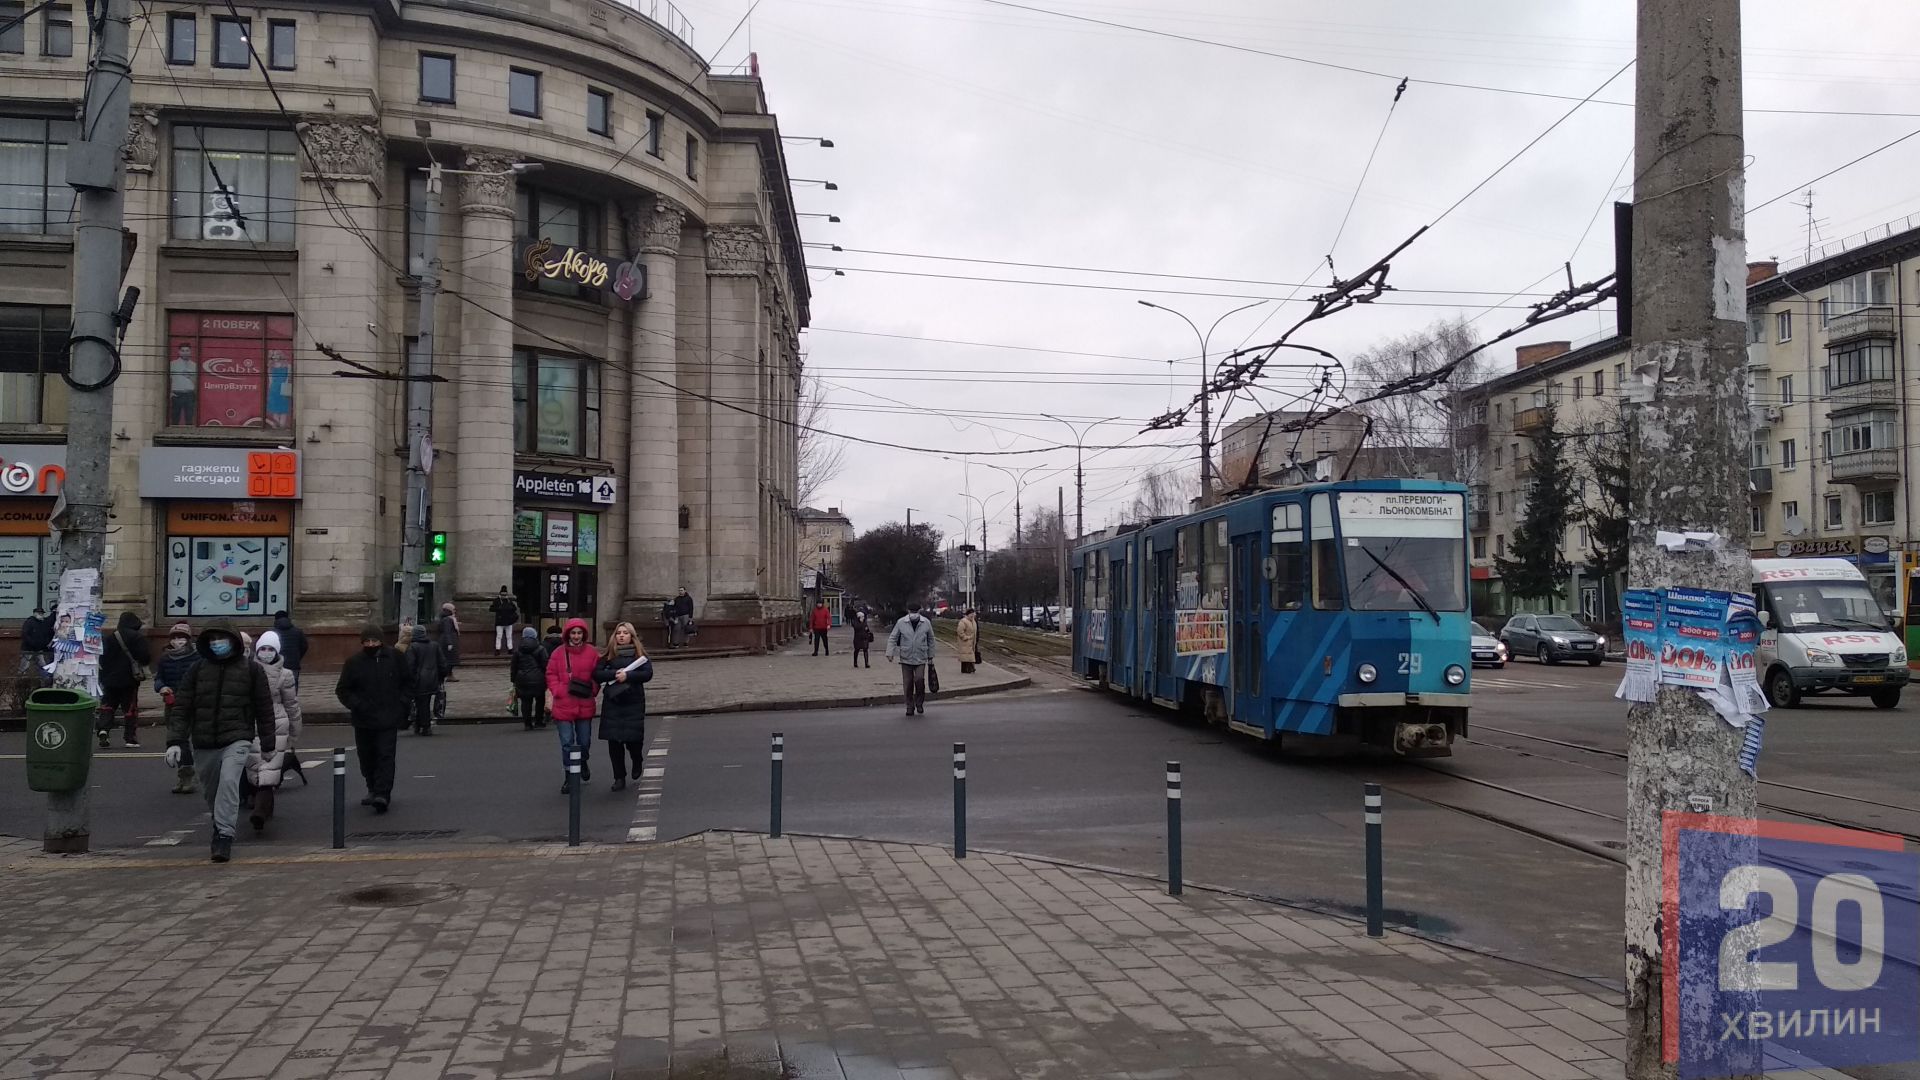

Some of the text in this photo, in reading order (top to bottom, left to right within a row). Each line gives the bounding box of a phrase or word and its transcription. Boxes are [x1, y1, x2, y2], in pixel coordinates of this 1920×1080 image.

[544, 247, 609, 286] Акорд
[203, 319, 260, 330] 2 ПОВЕРХ
[181, 465, 240, 475] гаджети
[174, 474, 240, 484] аксесуари
[602, 484, 609, 496] 3
[1379, 506, 1453, 516] ЛЬОНОКОМБІНАТ
[181, 512, 278, 522] UNIFON.COM.UA
[1760, 568, 1809, 581] RST
[1822, 635, 1881, 646] RST
[1397, 652, 1422, 674] 29
